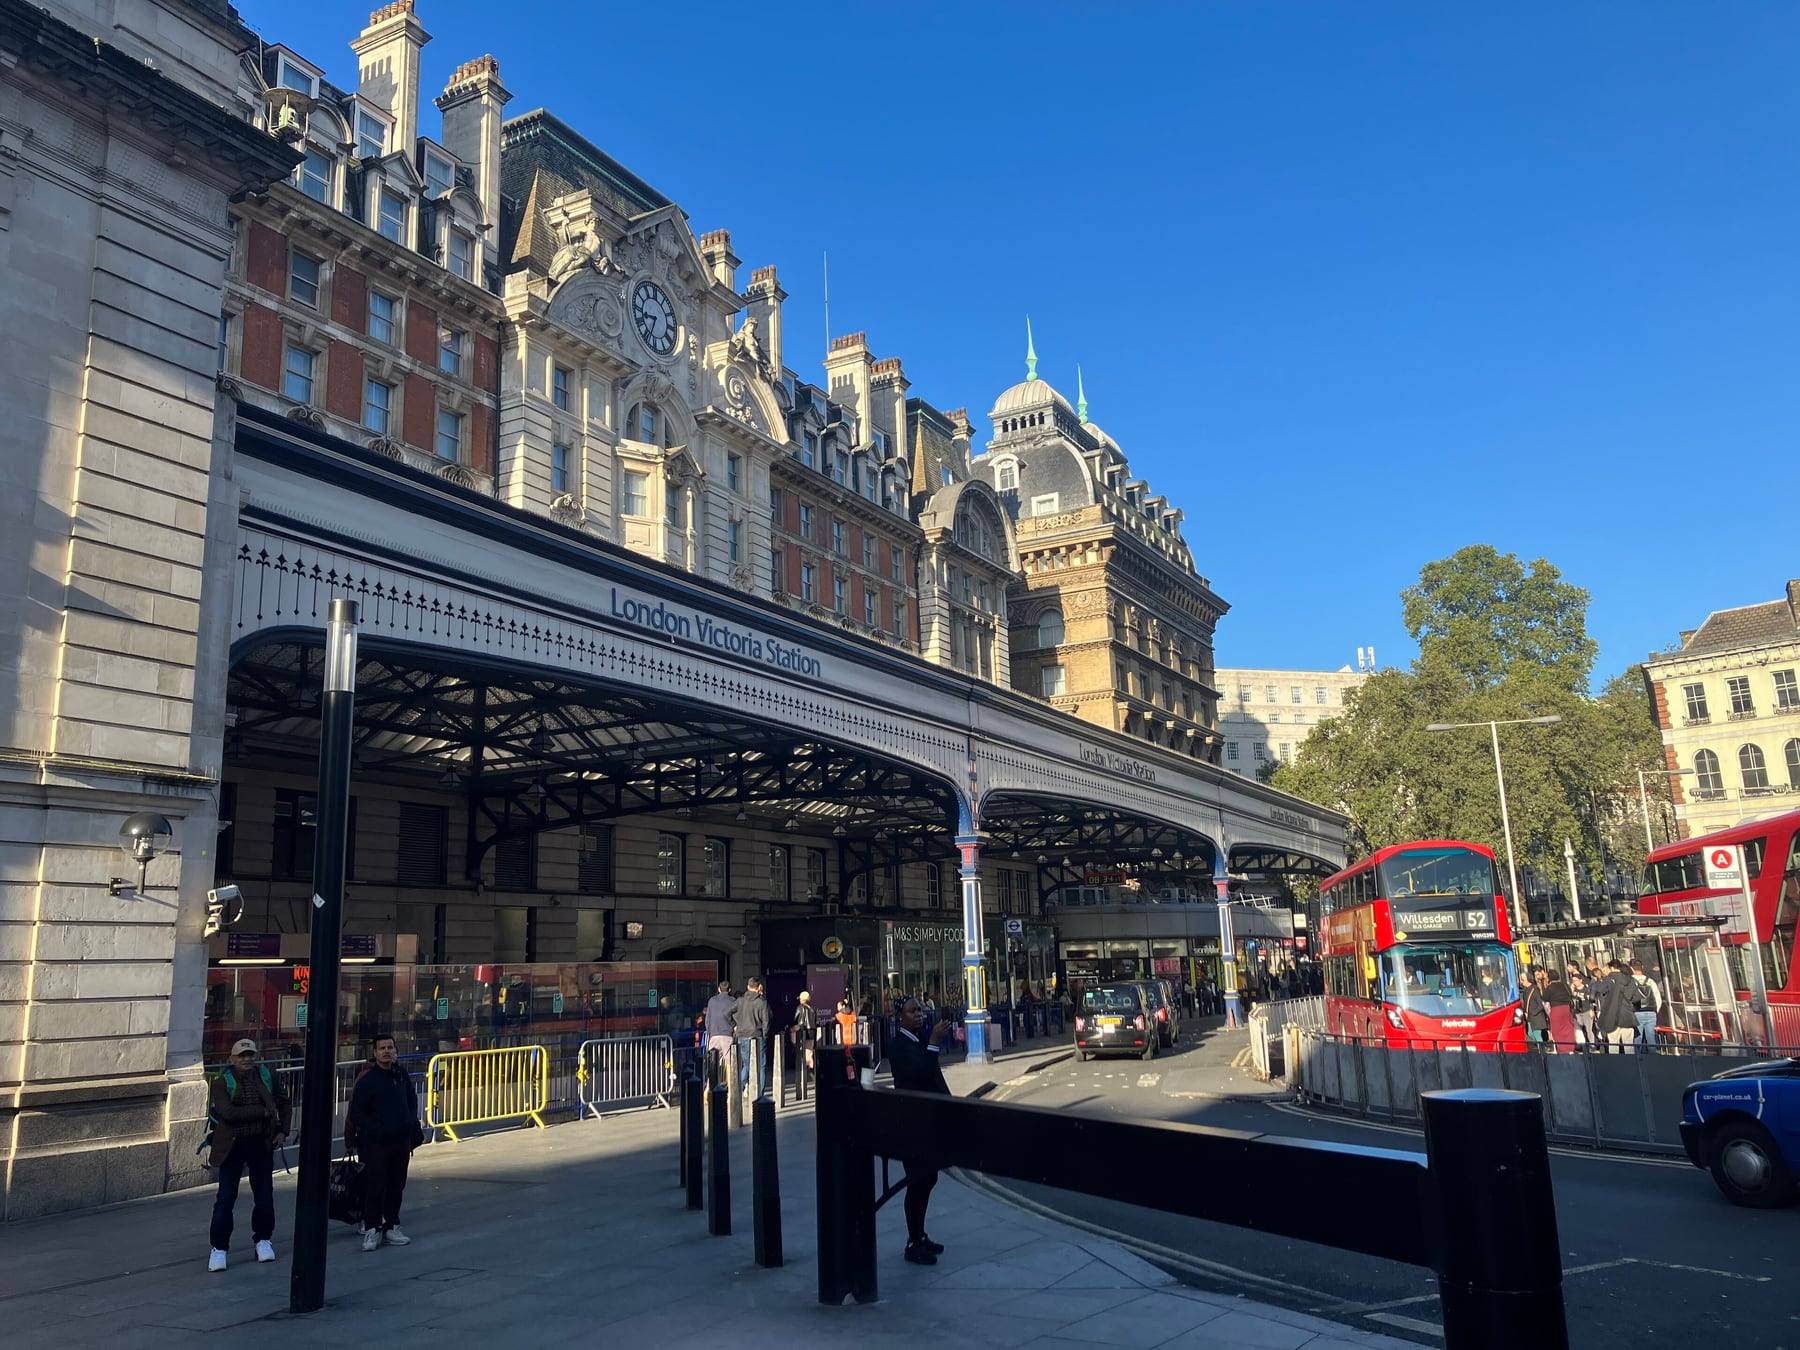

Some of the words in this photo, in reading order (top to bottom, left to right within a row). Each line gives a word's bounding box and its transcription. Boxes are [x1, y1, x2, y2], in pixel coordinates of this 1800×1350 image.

[611, 587, 690, 638] London
[695, 614, 762, 660] Victoria
[766, 639, 821, 678] Station
[1716, 853, 1728, 865] A
[1399, 912, 1454, 925] Willesden
[1467, 912, 1487, 927] 52
[893, 926, 912, 942] M&S
[913, 927, 943, 942] SIMPLY
[1441, 1019, 1477, 1028] Metroline
